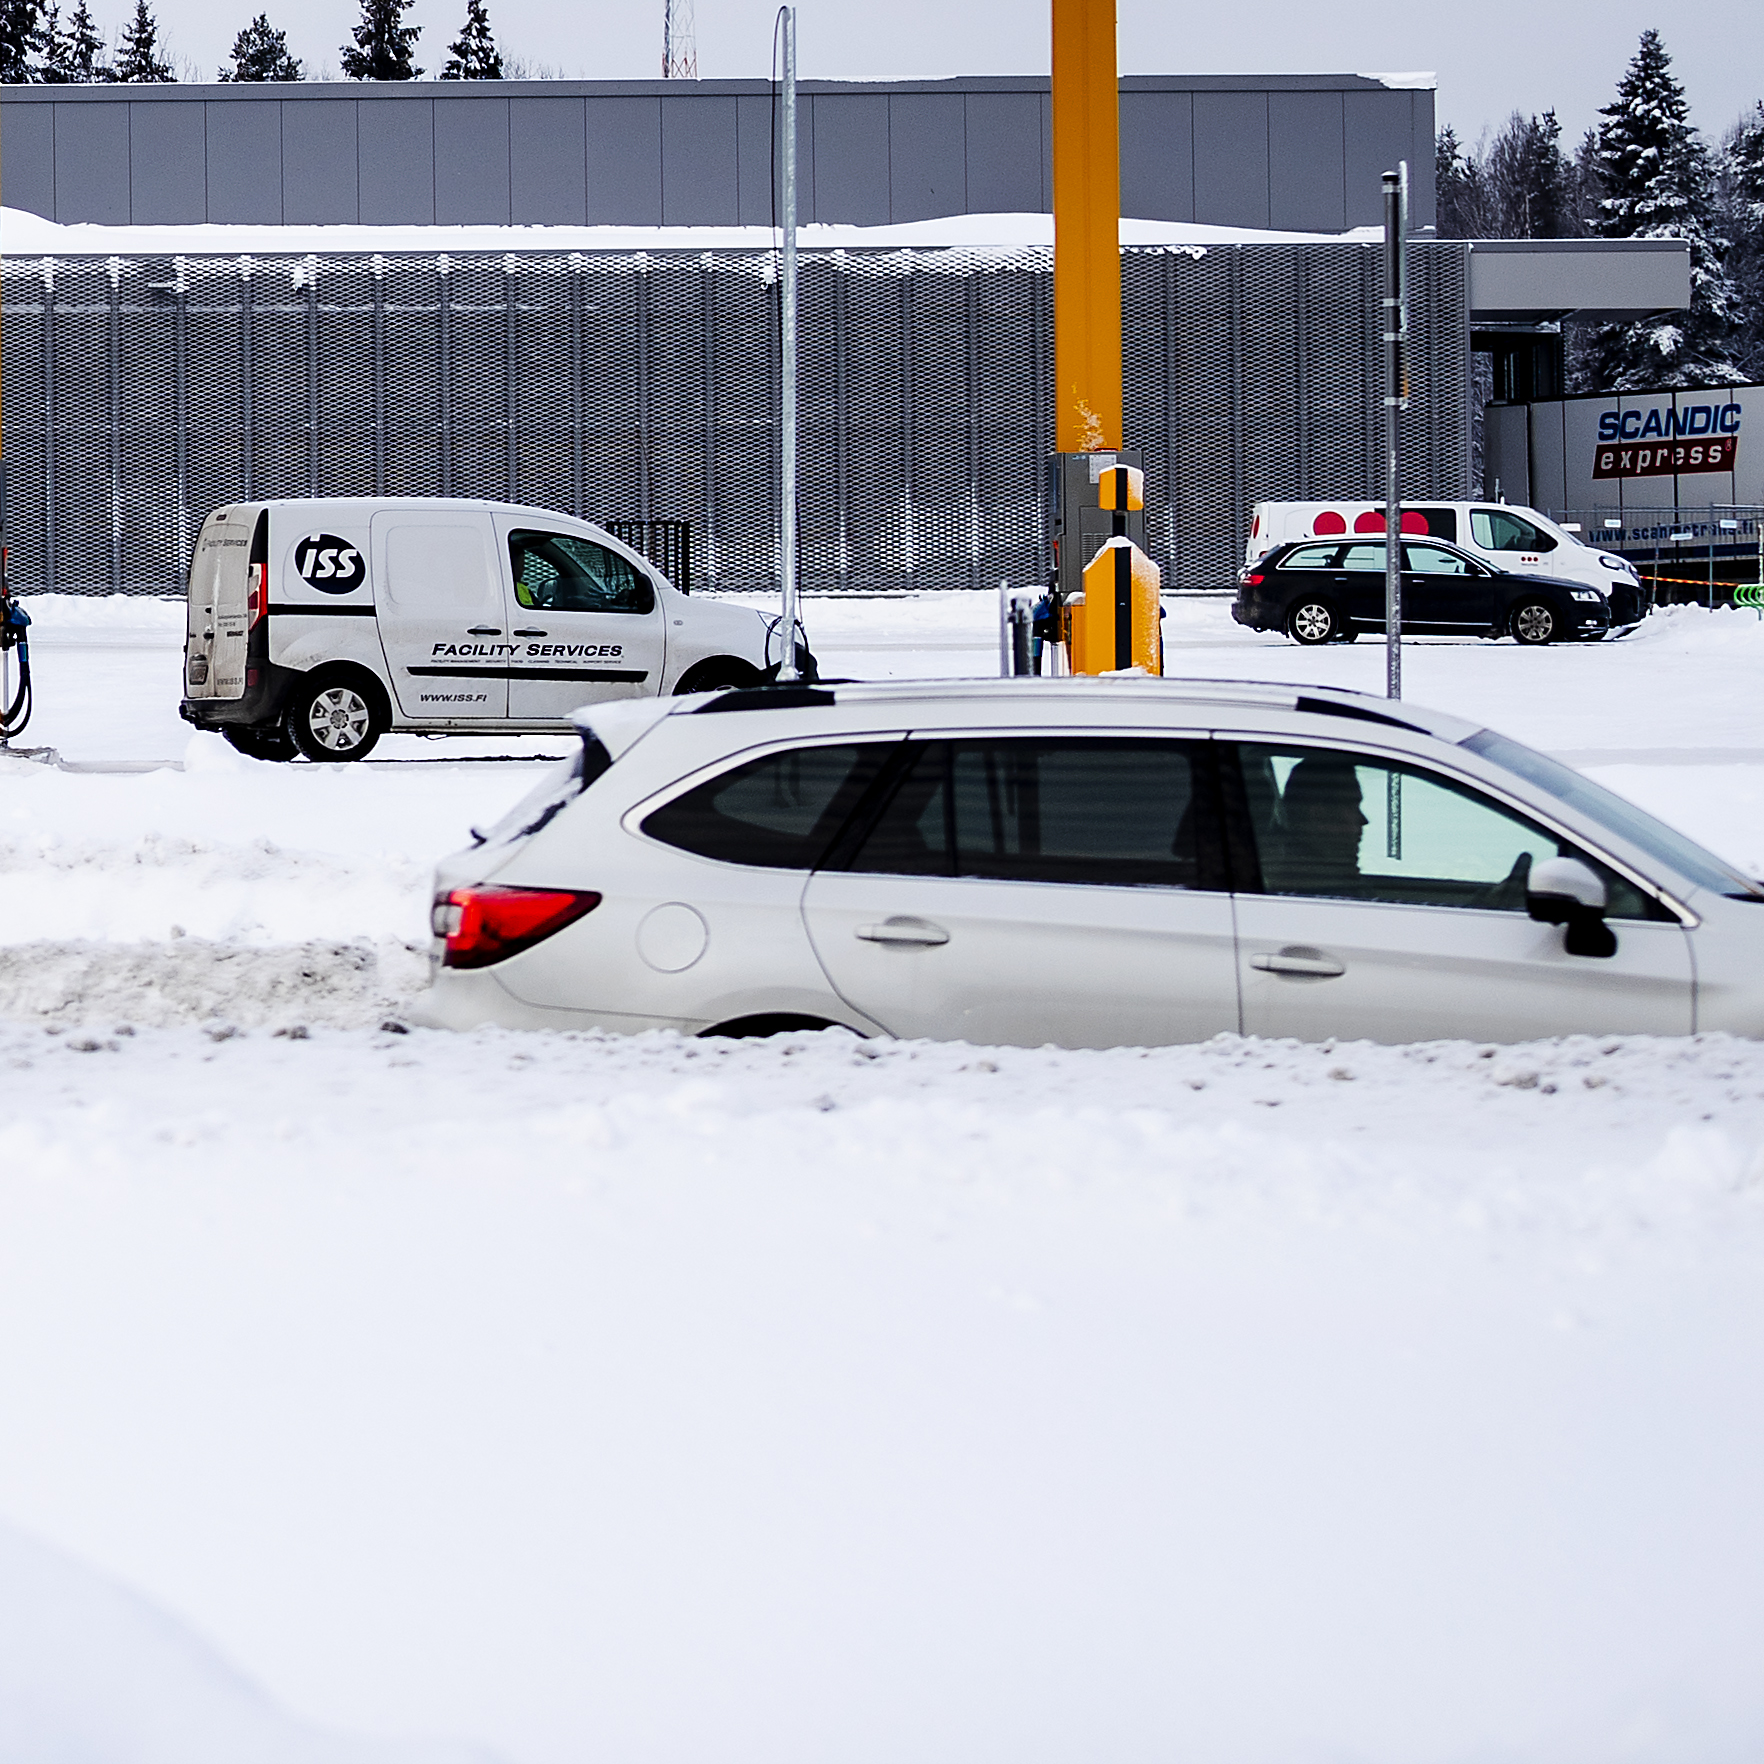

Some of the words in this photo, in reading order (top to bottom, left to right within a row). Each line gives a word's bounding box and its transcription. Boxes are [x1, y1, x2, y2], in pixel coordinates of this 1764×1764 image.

[1598, 403, 1742, 441] SCANDIC
[431, 643, 521, 656] FACILITY
[526, 644, 623, 657] SERVICES
[420, 694, 487, 702] WWW.ISS.FI
